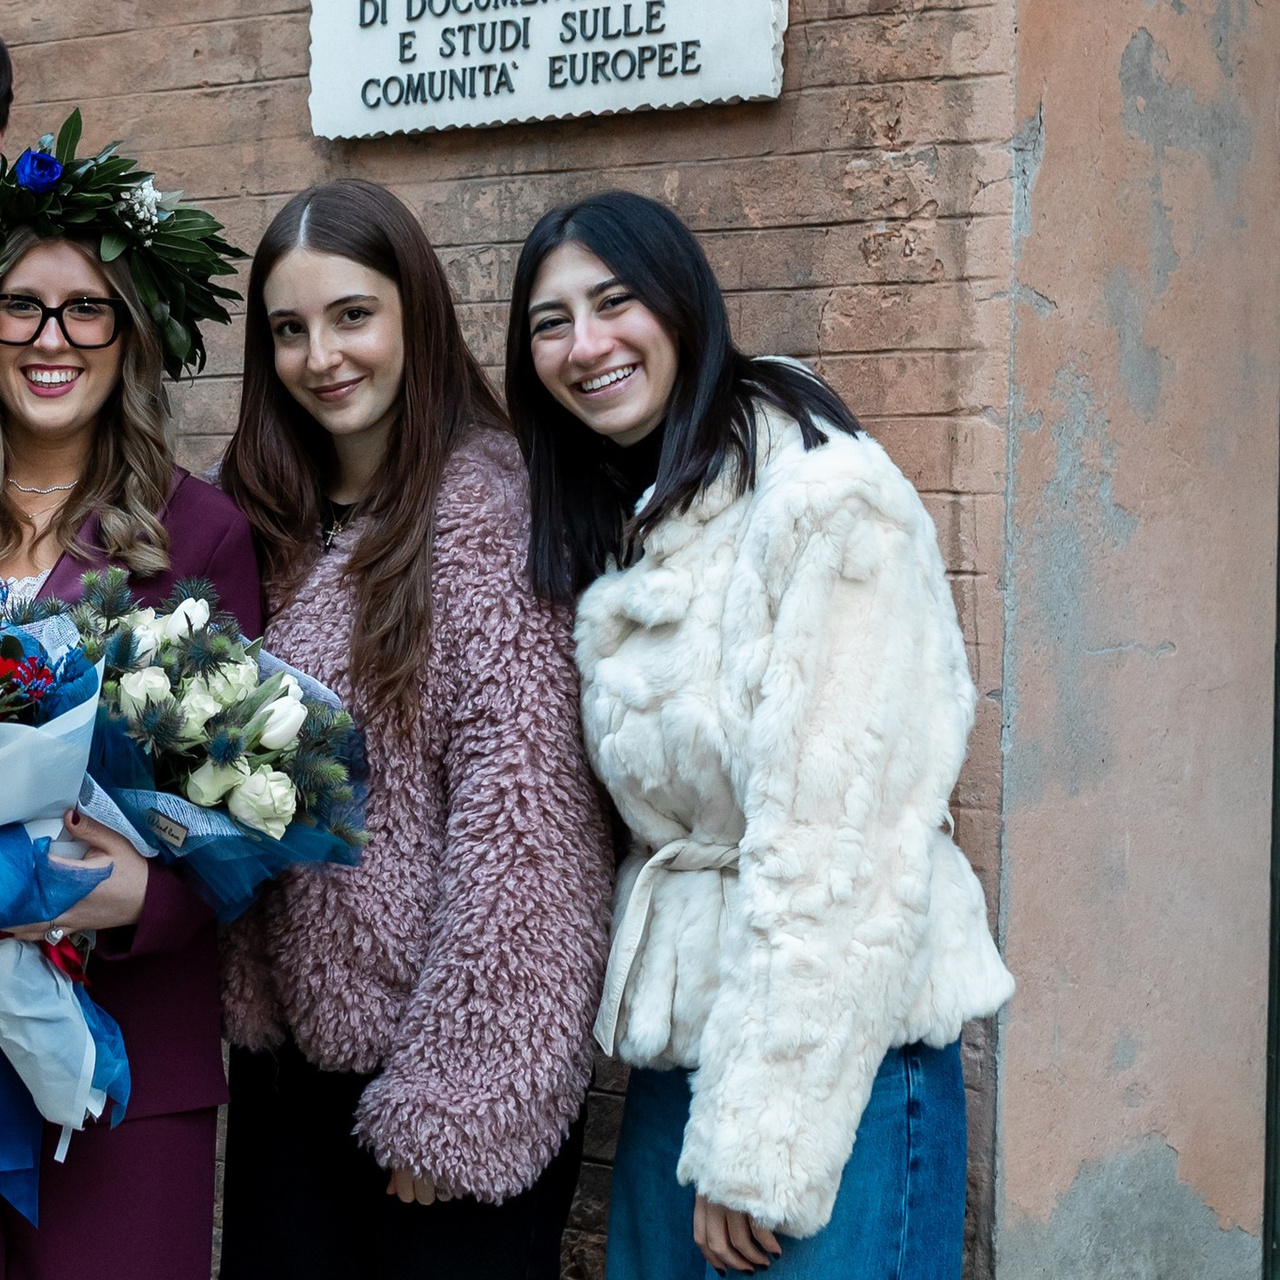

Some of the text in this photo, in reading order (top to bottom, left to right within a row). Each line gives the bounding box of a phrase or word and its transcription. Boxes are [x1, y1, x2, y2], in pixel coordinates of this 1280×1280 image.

[398, 0, 666, 65] E STUDI SULLE
[547, 39, 702, 91] EUROPEE
